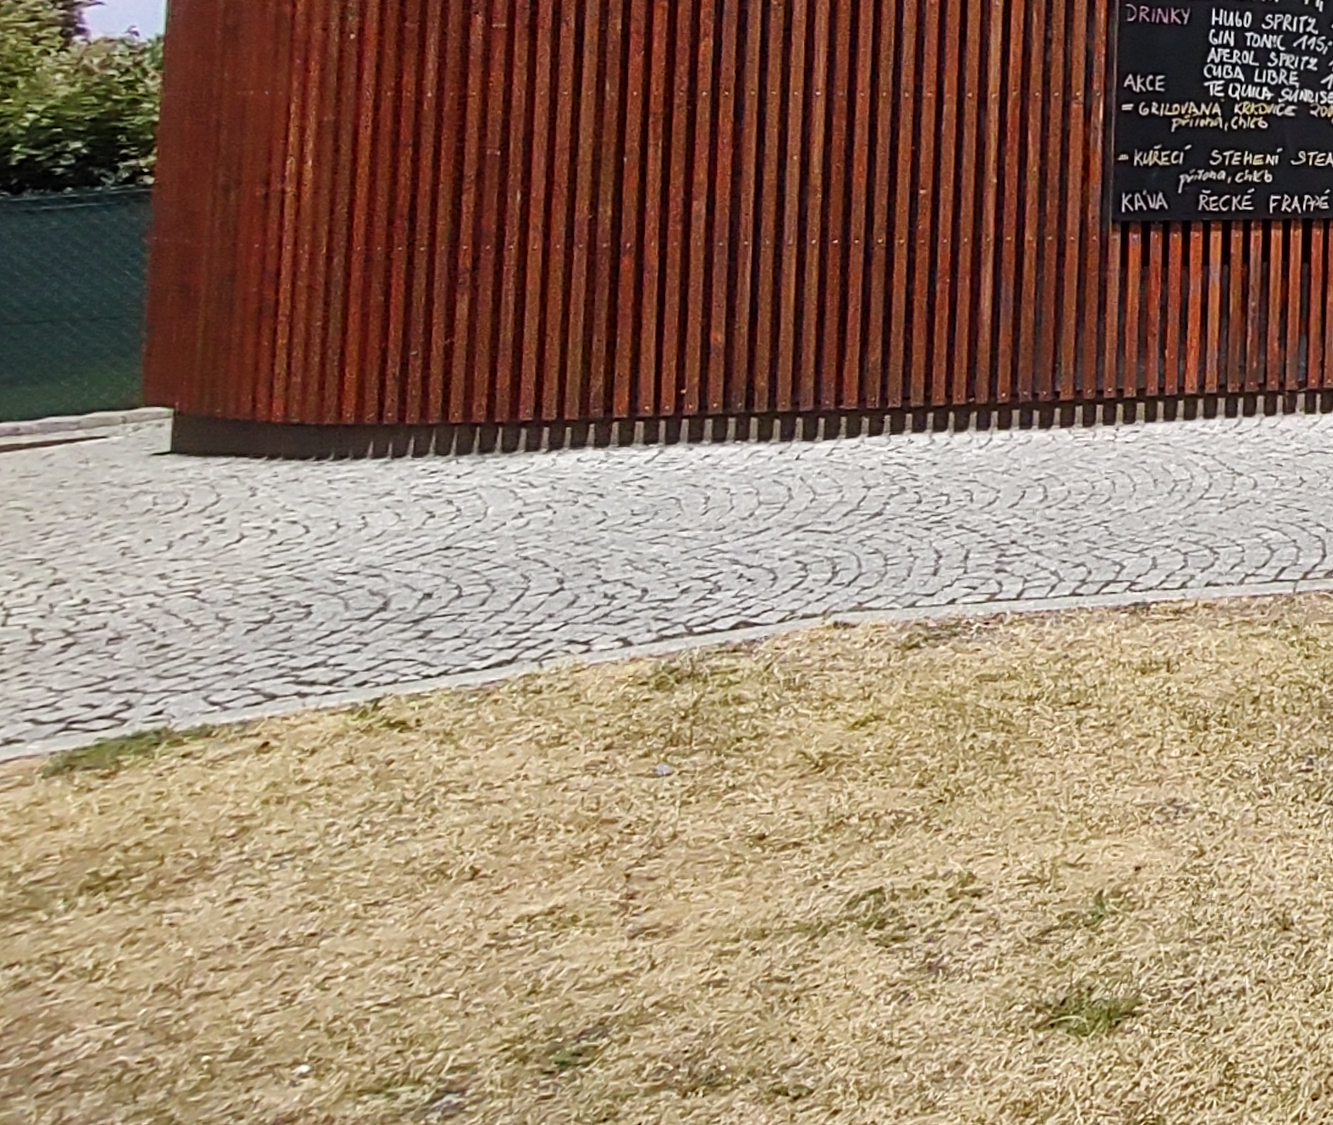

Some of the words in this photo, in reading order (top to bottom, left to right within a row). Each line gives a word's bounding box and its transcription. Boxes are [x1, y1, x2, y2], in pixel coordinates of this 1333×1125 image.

[1125, 3, 1191, 25] DRINKY
[1211, 7, 1253, 28] HUGO
[1261, 14, 1319, 35] SPRITZ
[1208, 28, 1235, 47] GIN
[1244, 31, 1286, 51] TONIC
[1206, 47, 1260, 67] APEROL
[1267, 51, 1318, 71] SPRITZ
[1123, 73, 1166, 93] AKCE
[1203, 63, 1245, 82] CUBA
[1254, 67, 1300, 88] LIBRE
[1234, 101, 1298, 117] KRKOVICE
[1133, 144, 1193, 167] KUŘECÍ
[1121, 190, 1169, 213] KÁVA
[1198, 187, 1256, 212] ŘECKÉ
[1269, 189, 1330, 215] FRAPPÉ
